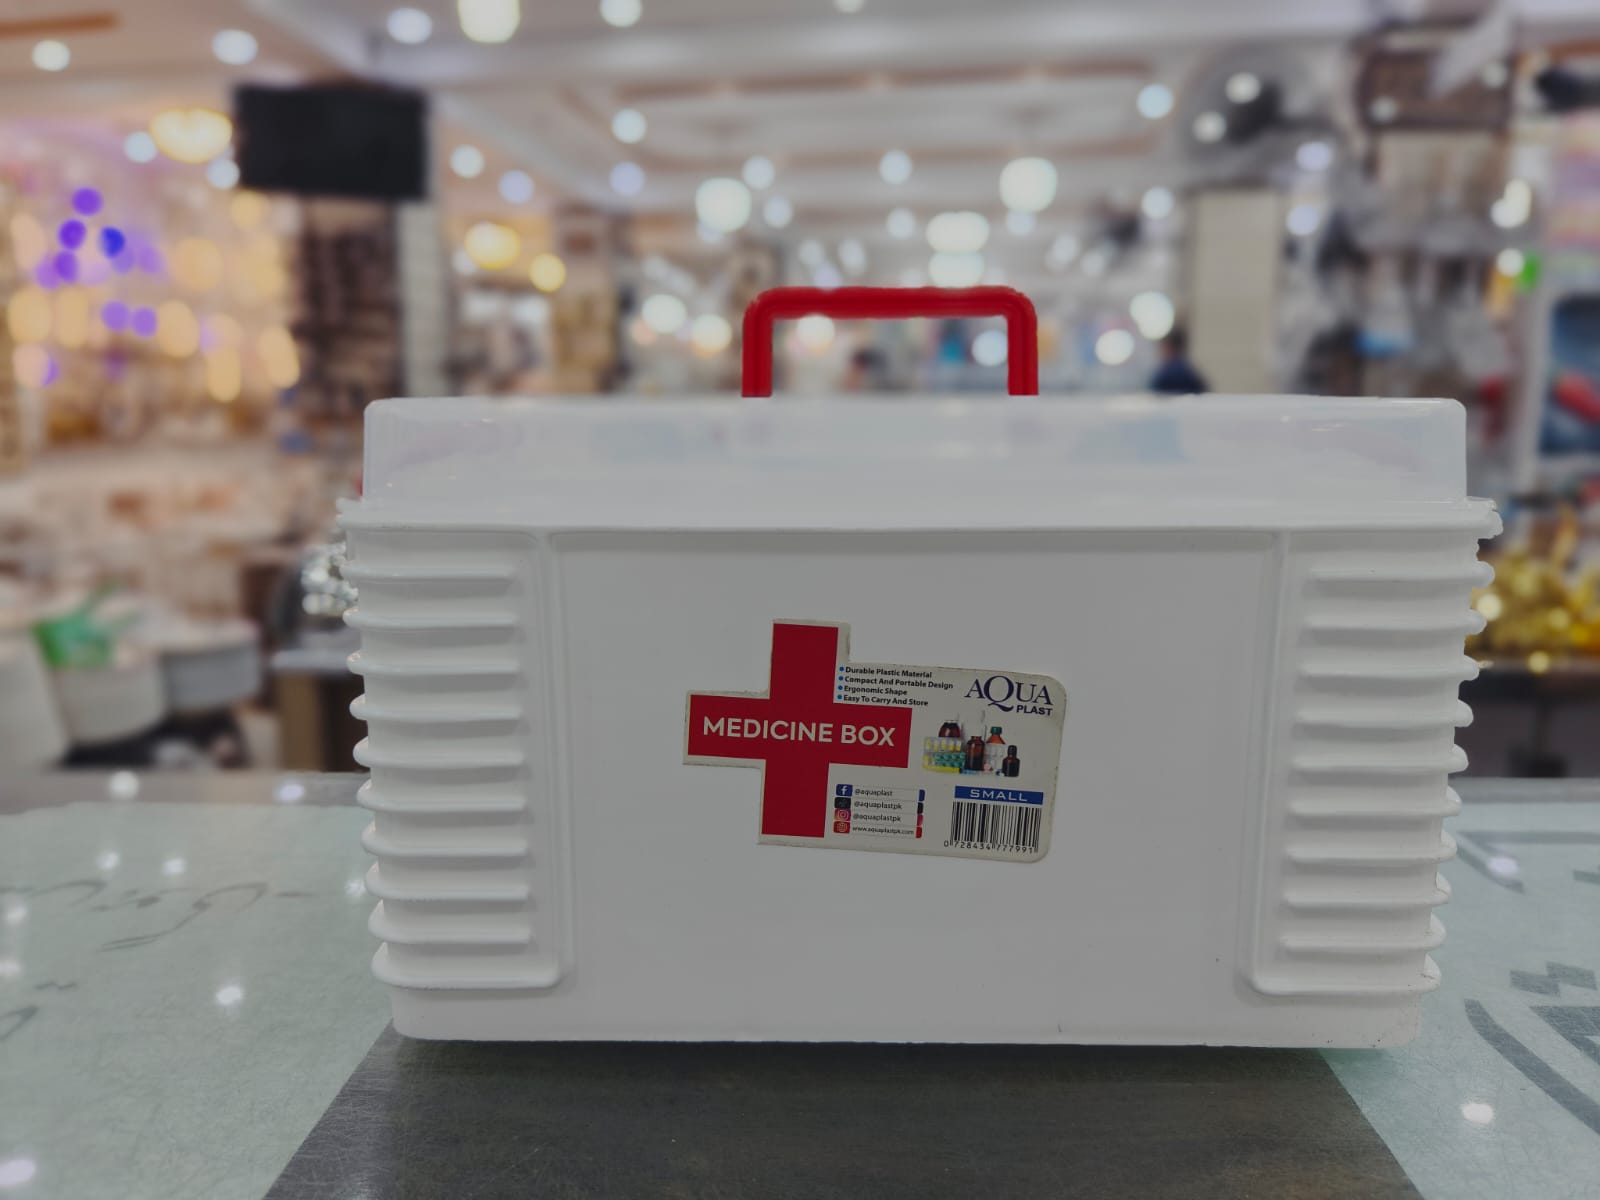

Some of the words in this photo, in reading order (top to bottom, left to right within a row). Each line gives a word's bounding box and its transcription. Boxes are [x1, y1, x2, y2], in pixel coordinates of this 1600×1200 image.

[845, 666, 875, 675] Durable
[876, 668, 900, 677] Plastic
[901, 670, 932, 678] Material
[844, 676, 877, 685] Compact
[878, 678, 894, 686] And
[895, 680, 927, 688] Portable
[928, 681, 953, 690] Design
[844, 685, 884, 694] Ergonomic
[885, 688, 908, 697] Shape
[964, 675, 1053, 712] AQUA
[843, 695, 860, 703] Easy
[871, 697, 891, 705] Carry
[1016, 704, 1053, 716] PLAST
[703, 716, 833, 742] MEDICINE
[841, 725, 896, 747] BOX
[855, 788, 892, 797] @aquaplast
[970, 789, 1028, 802] SMALL
[854, 801, 902, 810] @aquaplastpk
[853, 813, 901, 822] @aquaplastpk
